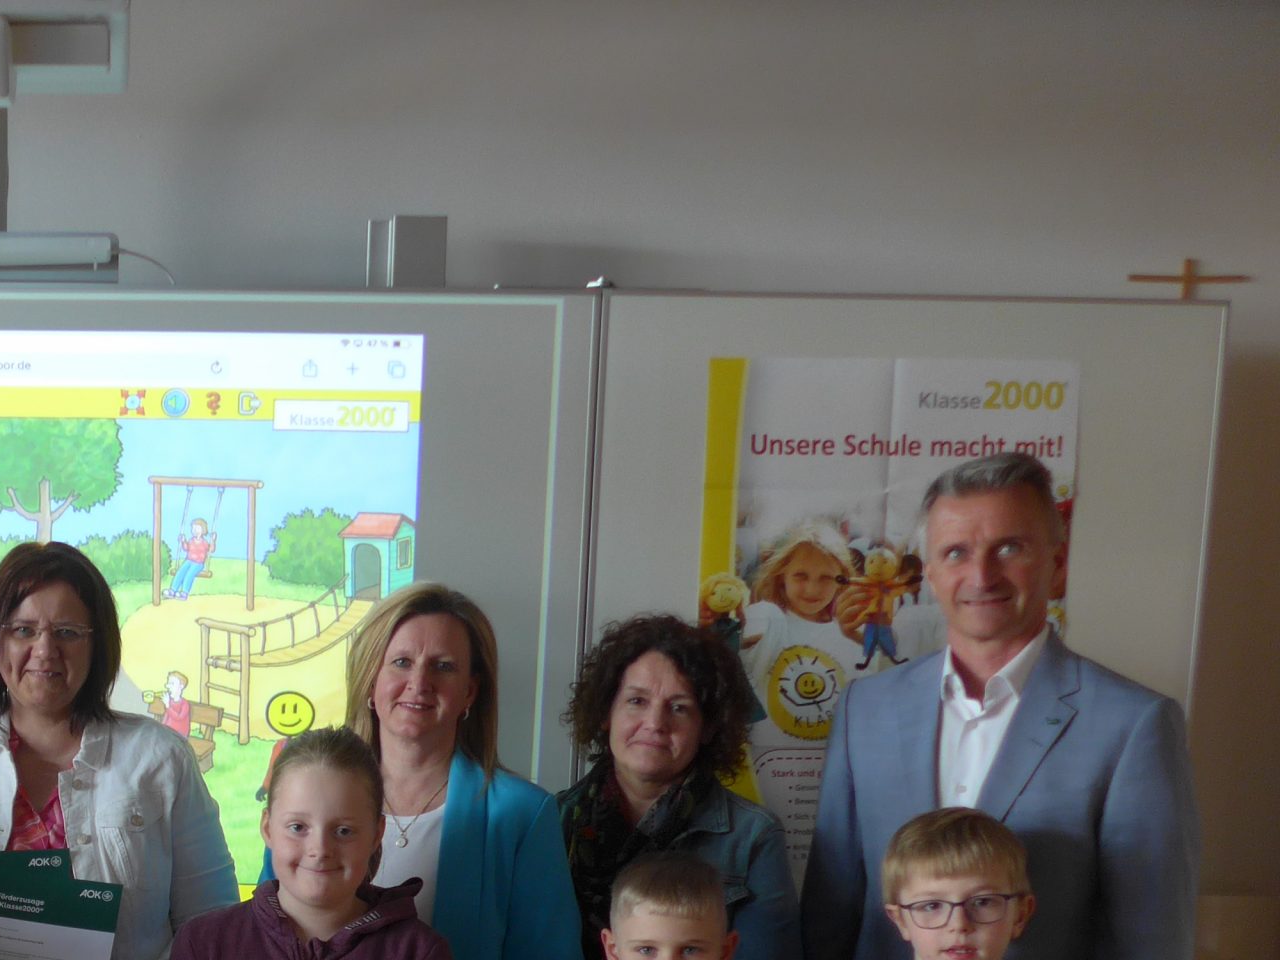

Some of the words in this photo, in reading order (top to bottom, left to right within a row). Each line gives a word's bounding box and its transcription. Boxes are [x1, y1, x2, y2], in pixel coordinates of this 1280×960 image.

[750, 433, 836, 458] Unsere
[843, 433, 922, 458] Schule
[930, 434, 1006, 457] macht
[1015, 435, 1064, 457] mit!
[28, 857, 50, 867] AOK
[80, 889, 101, 900] AOK
